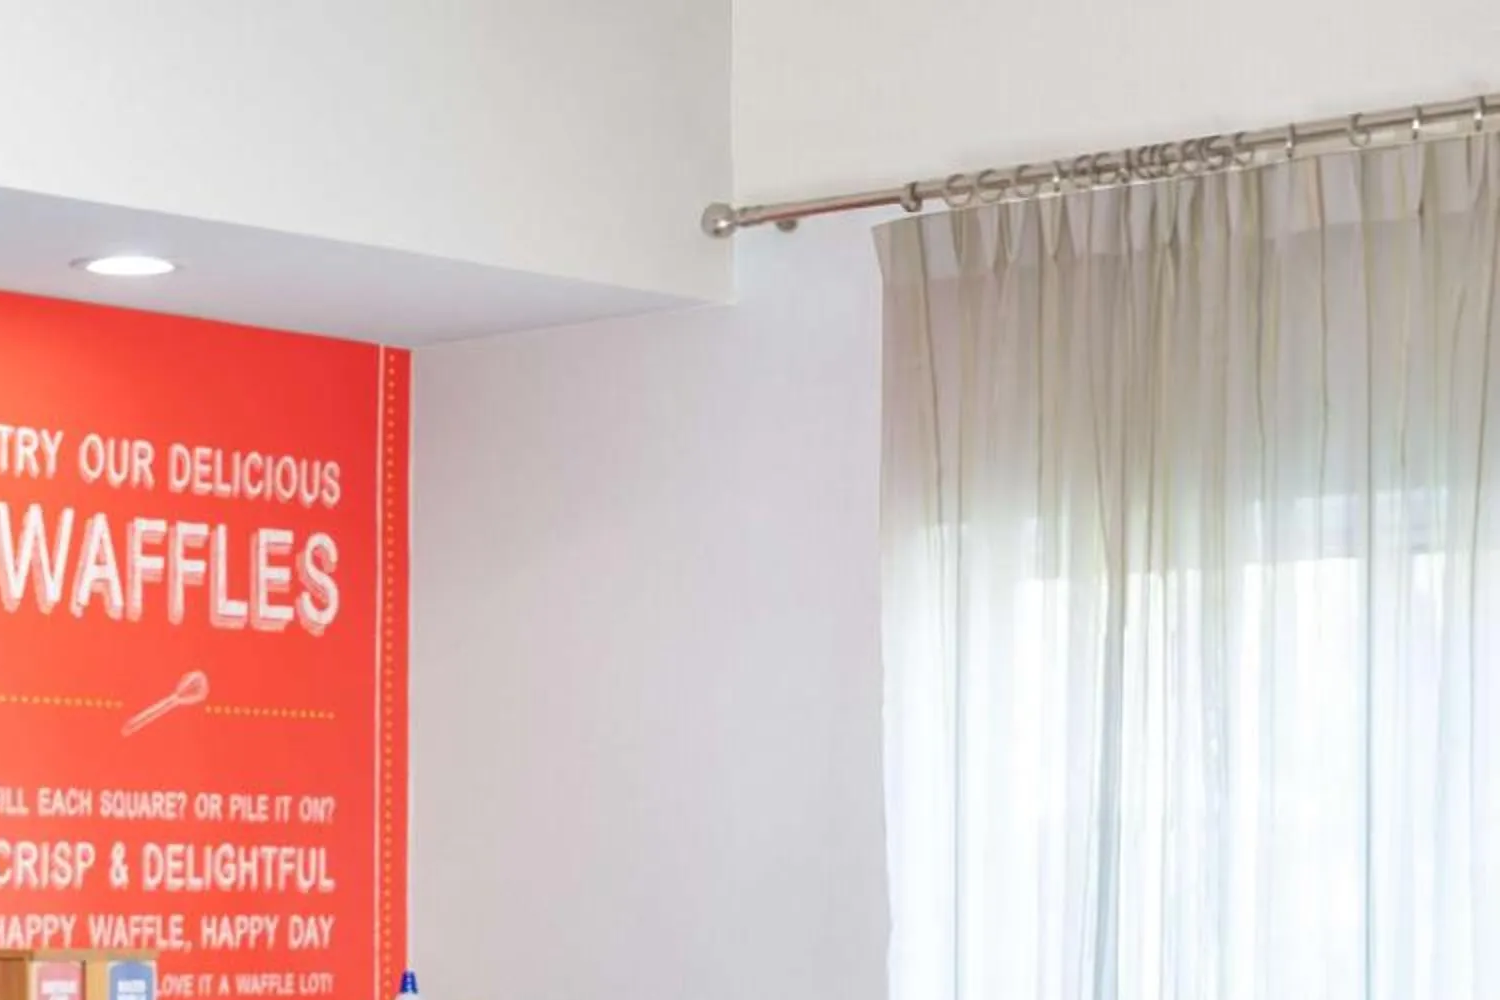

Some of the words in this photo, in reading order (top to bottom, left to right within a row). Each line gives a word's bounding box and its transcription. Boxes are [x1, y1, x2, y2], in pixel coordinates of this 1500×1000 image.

[79, 433, 155, 489] OUR
[169, 443, 342, 508] DELICIOUS
[38, 786, 93, 817] EACH
[100, 789, 188, 821] SQUARE?
[194, 791, 223, 822] OR
[230, 793, 270, 823] PILE
[275, 796, 293, 824] IT
[299, 796, 336, 824] ON?
[110, 841, 130, 892] &
[142, 842, 336, 894] DELIGHTFUL
[88, 914, 192, 953] WAFFLE,
[202, 915, 279, 950] HAPPY
[288, 914, 336, 951] DAY
[198, 973, 213, 996] IT
[218, 973, 230, 996] A
[235, 972, 295, 996] WAFFLE
